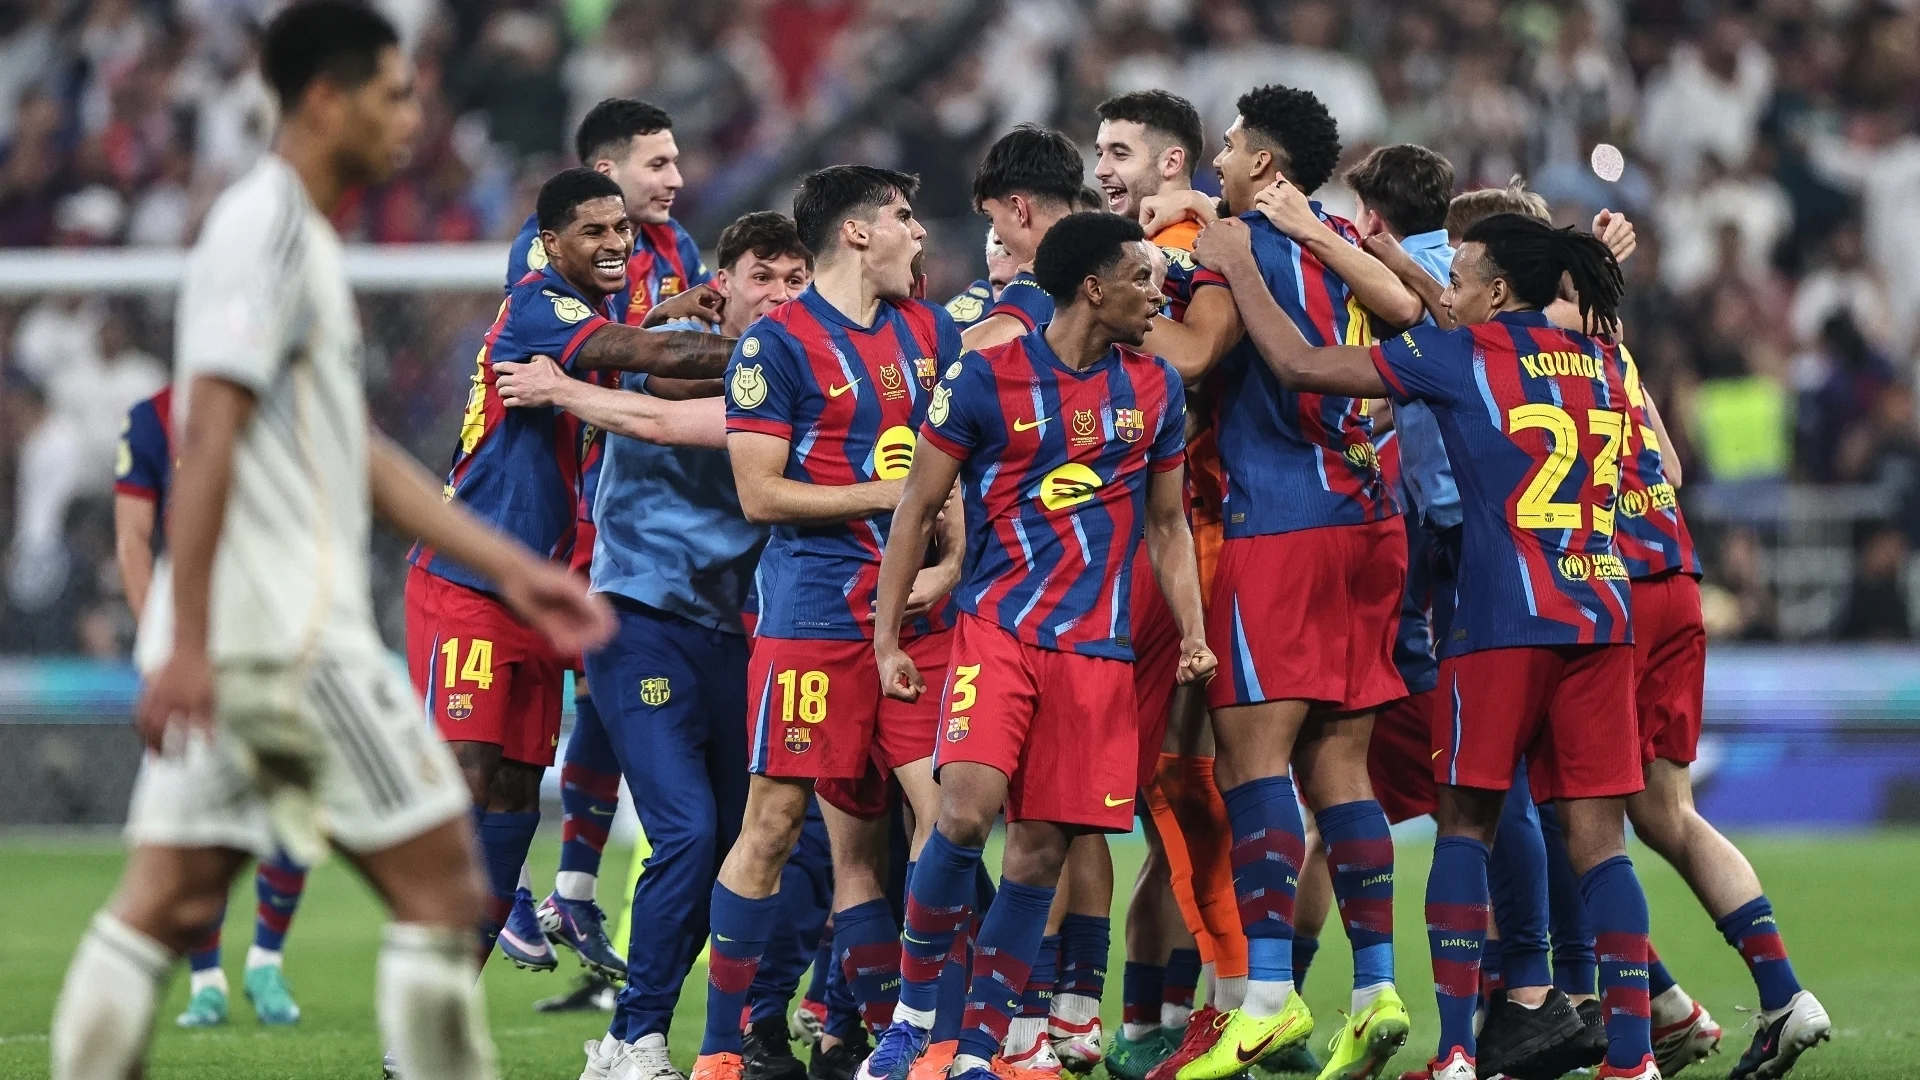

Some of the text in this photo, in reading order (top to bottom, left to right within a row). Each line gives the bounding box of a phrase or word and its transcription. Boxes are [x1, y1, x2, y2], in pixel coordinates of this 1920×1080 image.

[1520, 351, 1606, 382] KOUNDE
[1508, 403, 1624, 537] 23
[441, 638, 493, 690] 14
[951, 663, 981, 713] 3
[777, 669, 830, 724] 18
[1440, 938, 1479, 950] BARÇA
[880, 977, 901, 992] BAR
